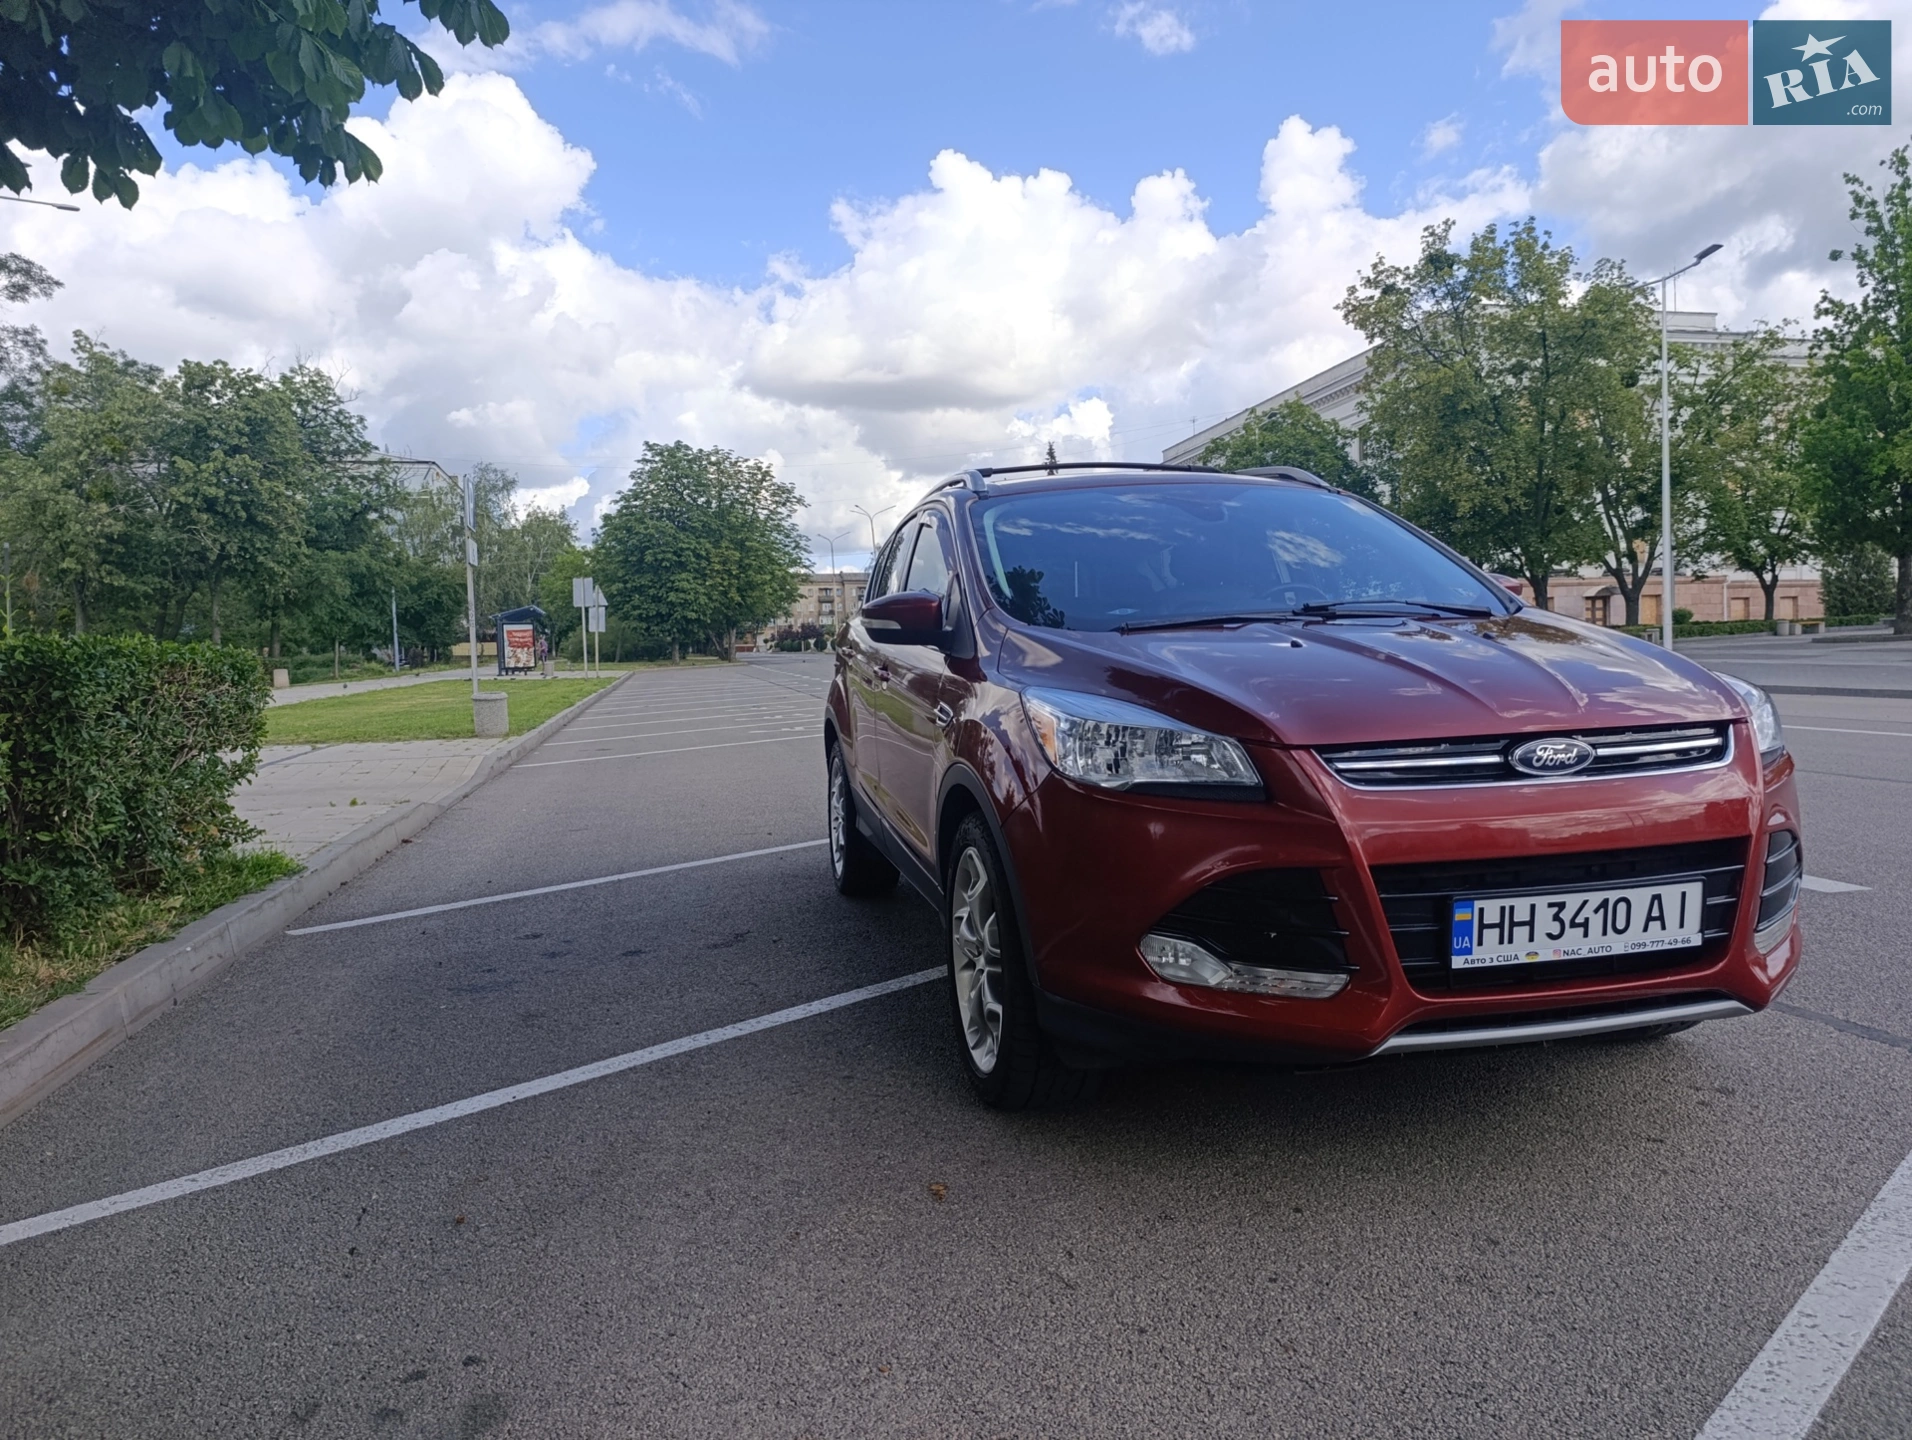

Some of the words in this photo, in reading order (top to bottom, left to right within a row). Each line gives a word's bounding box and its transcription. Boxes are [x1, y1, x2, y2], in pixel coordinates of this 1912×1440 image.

[1532, 744, 1578, 767] Ford
[1545, 896, 1632, 941] 3410
[1453, 936, 1471, 949] UA
[1630, 936, 1692, 950] 099-777-49-66
[1463, 957, 1487, 966] Авто
[1496, 953, 1520, 963] США
